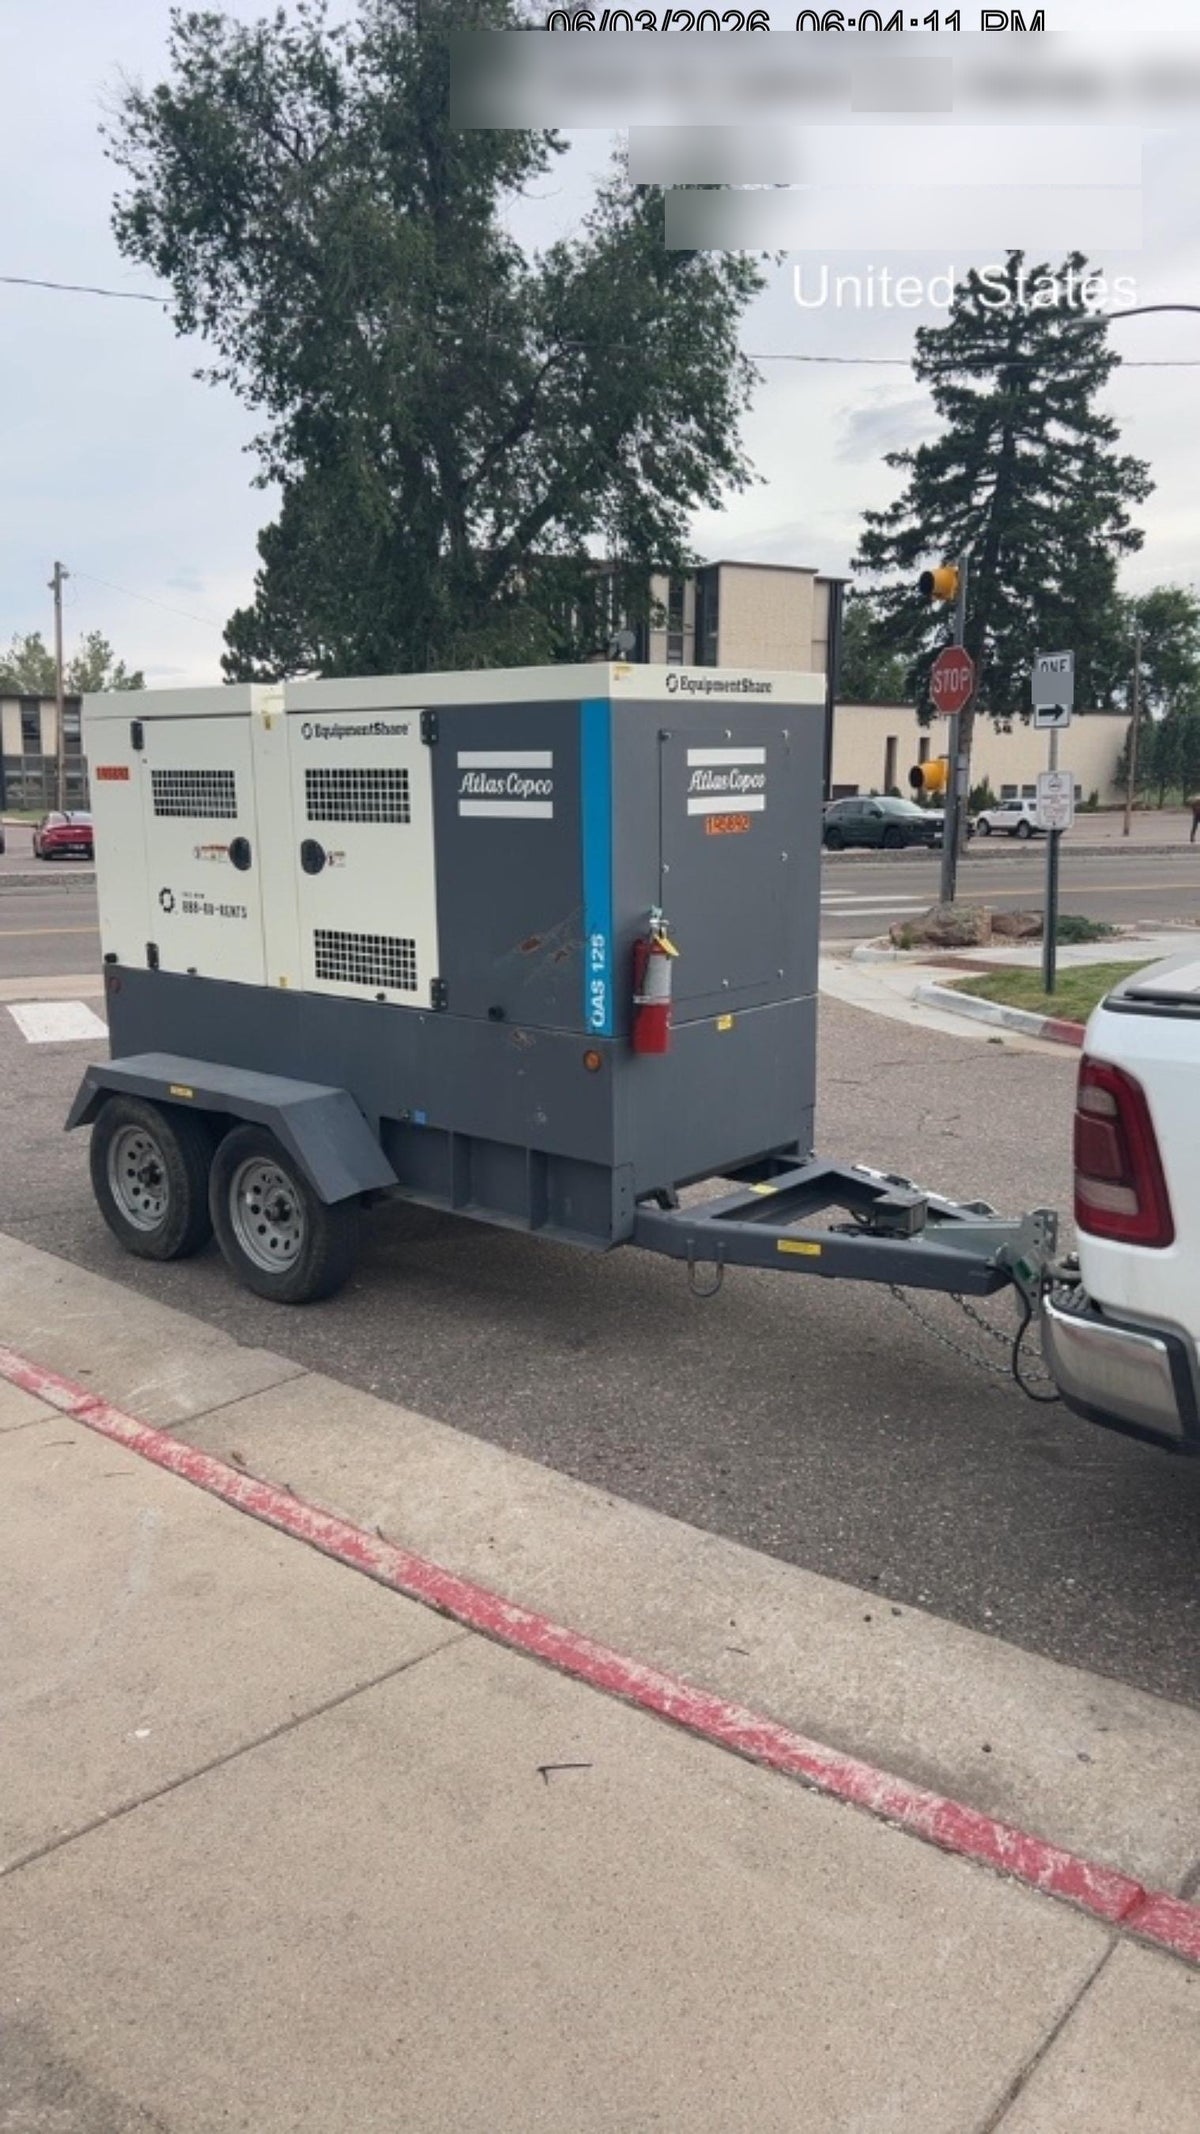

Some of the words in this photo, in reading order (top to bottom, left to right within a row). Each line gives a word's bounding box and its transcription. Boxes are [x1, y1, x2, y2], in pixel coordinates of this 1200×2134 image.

[680, 676, 772, 695] EquipmentShare
[934, 667, 970, 693] STOP
[315, 722, 409, 740] EquipmentShare
[458, 772, 506, 794] Atlas
[506, 772, 553, 799] Copco
[687, 769, 728, 792] Atlas
[729, 768, 766, 793] Copco
[590, 933, 605, 973] 125
[590, 979, 606, 1028] QAS
